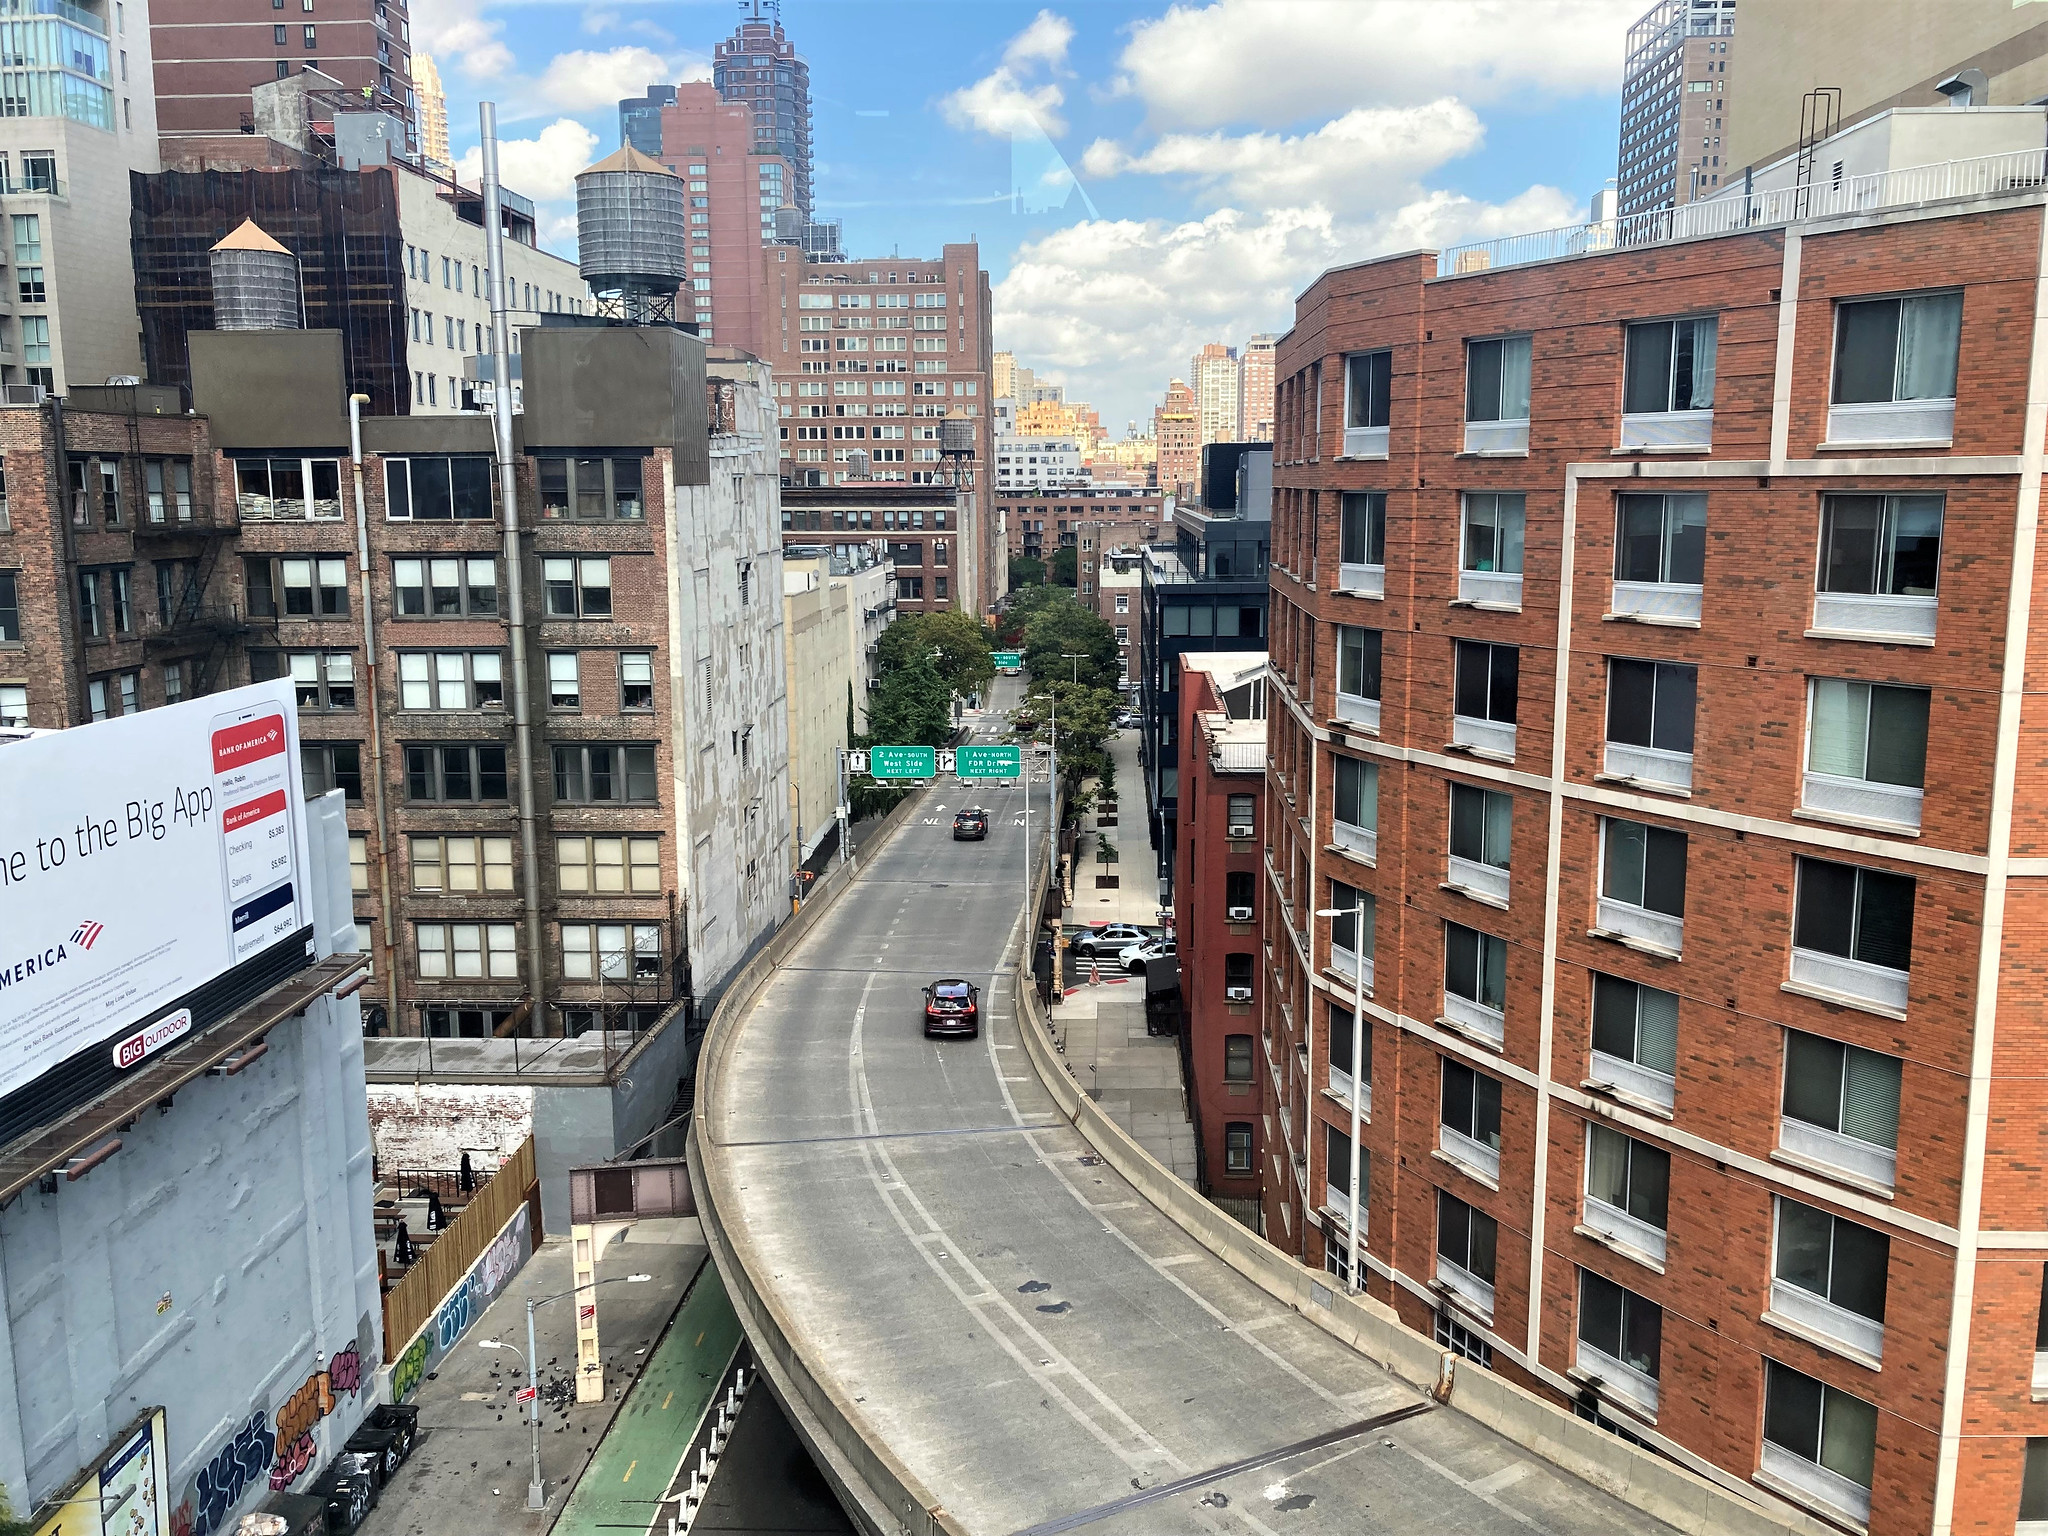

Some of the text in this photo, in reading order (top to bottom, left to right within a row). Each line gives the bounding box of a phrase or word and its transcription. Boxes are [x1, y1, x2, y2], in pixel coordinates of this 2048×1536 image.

[218, 736, 267, 757] BANK OF AMERICA
[226, 807, 260, 826] Bank of America
[36, 837, 66, 872] to
[75, 815, 118, 857] the
[126, 799, 166, 841] Big
[173, 786, 213, 828] App
[228, 840, 253, 856] Checking
[231, 874, 252, 888] Savings
[237, 934, 265, 953] Retirement
[41, 1031, 54, 1041] Bank
[54, 1016, 80, 1034] Guaranteed
[122, 1016, 187, 1063] BIG OUTDOOR
